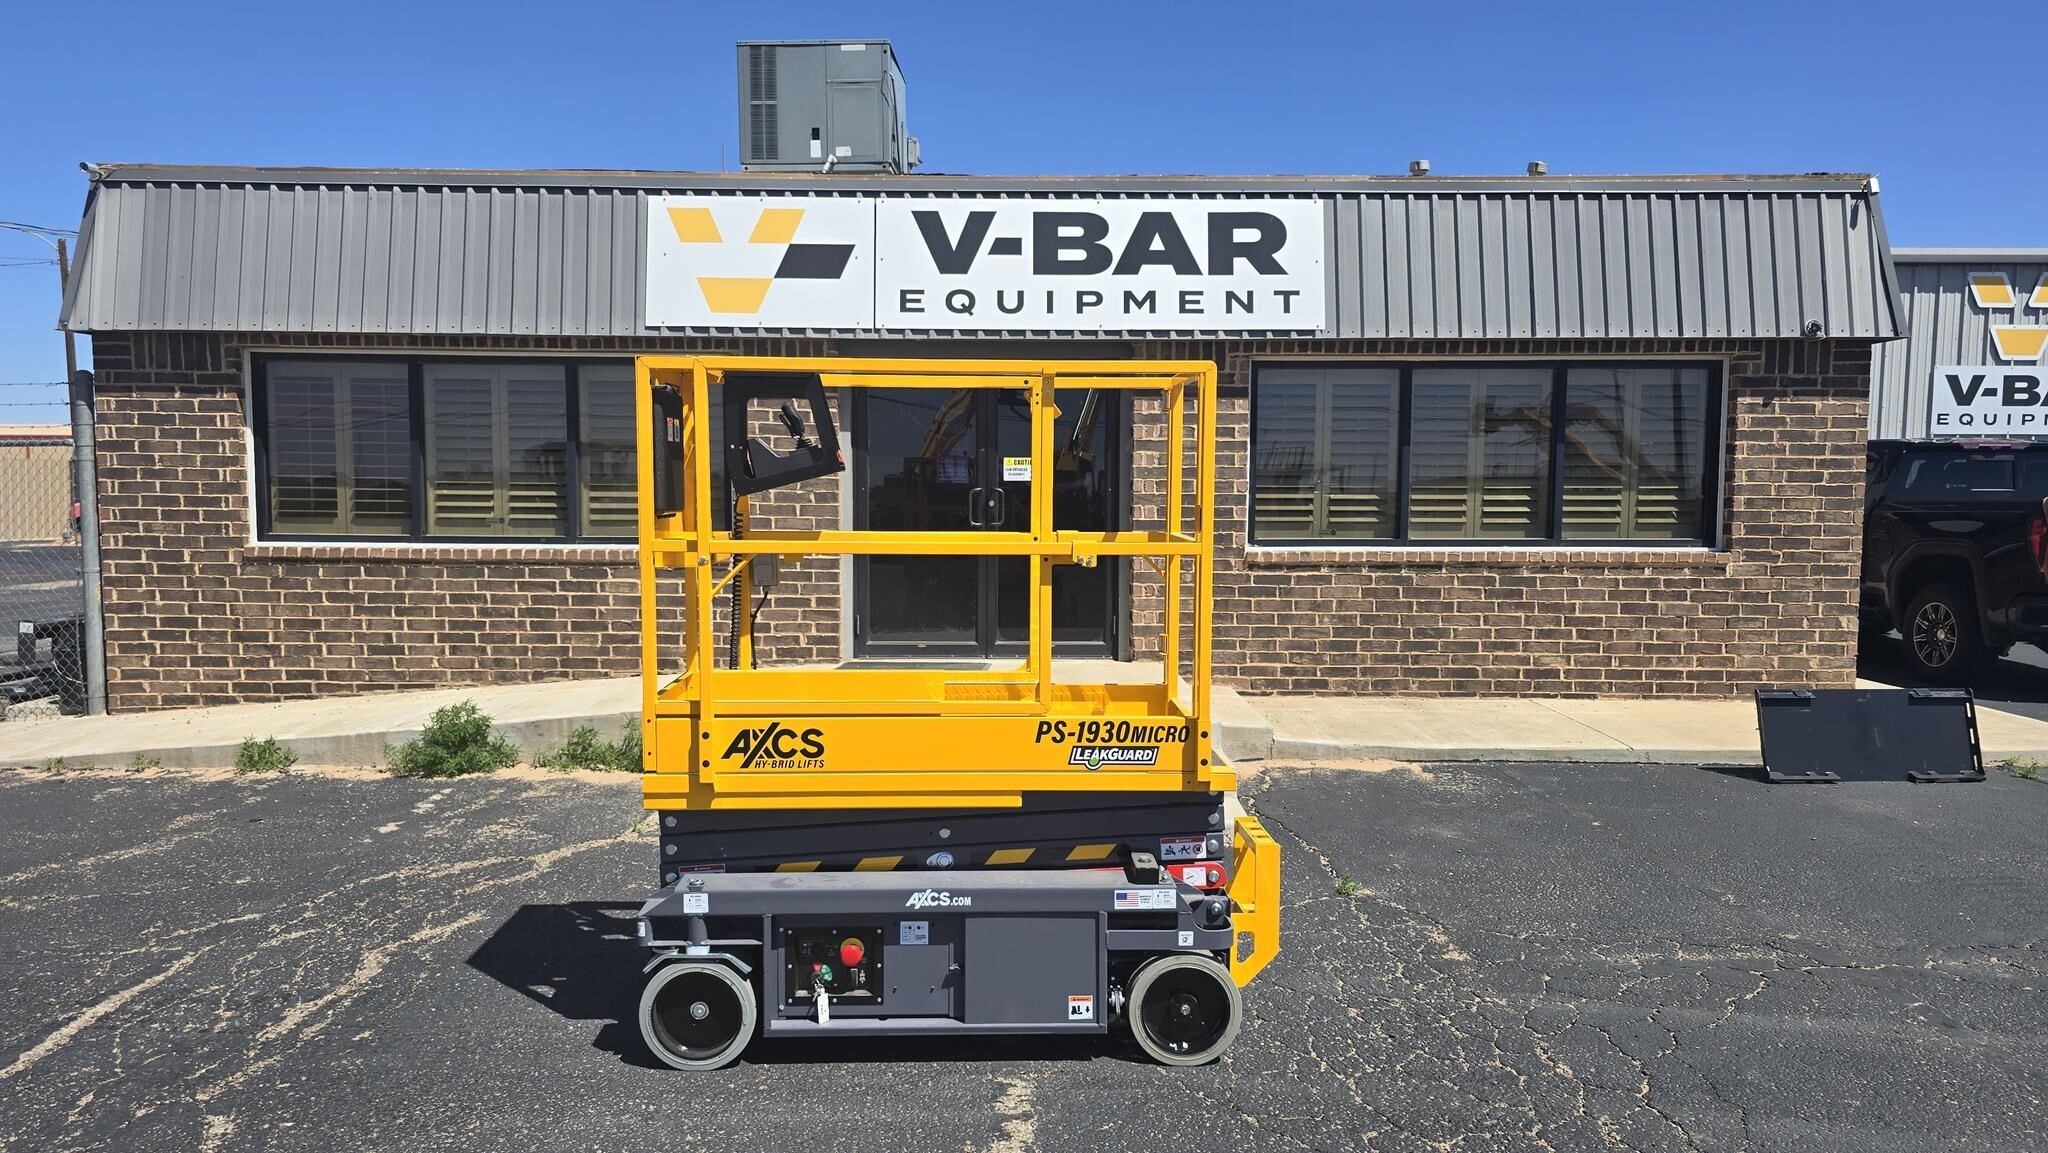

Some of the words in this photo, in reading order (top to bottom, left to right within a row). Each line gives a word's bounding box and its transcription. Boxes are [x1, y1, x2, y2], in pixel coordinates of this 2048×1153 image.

[911, 210, 1289, 276] V-BAR
[898, 289, 1301, 316] EQUIPMENT
[1945, 374, 2048, 407] V-B
[1936, 413, 2048, 427] EQUIP
[720, 722, 825, 769] AXCS
[754, 759, 795, 769] HY-BRID
[797, 759, 825, 769] LIFTS
